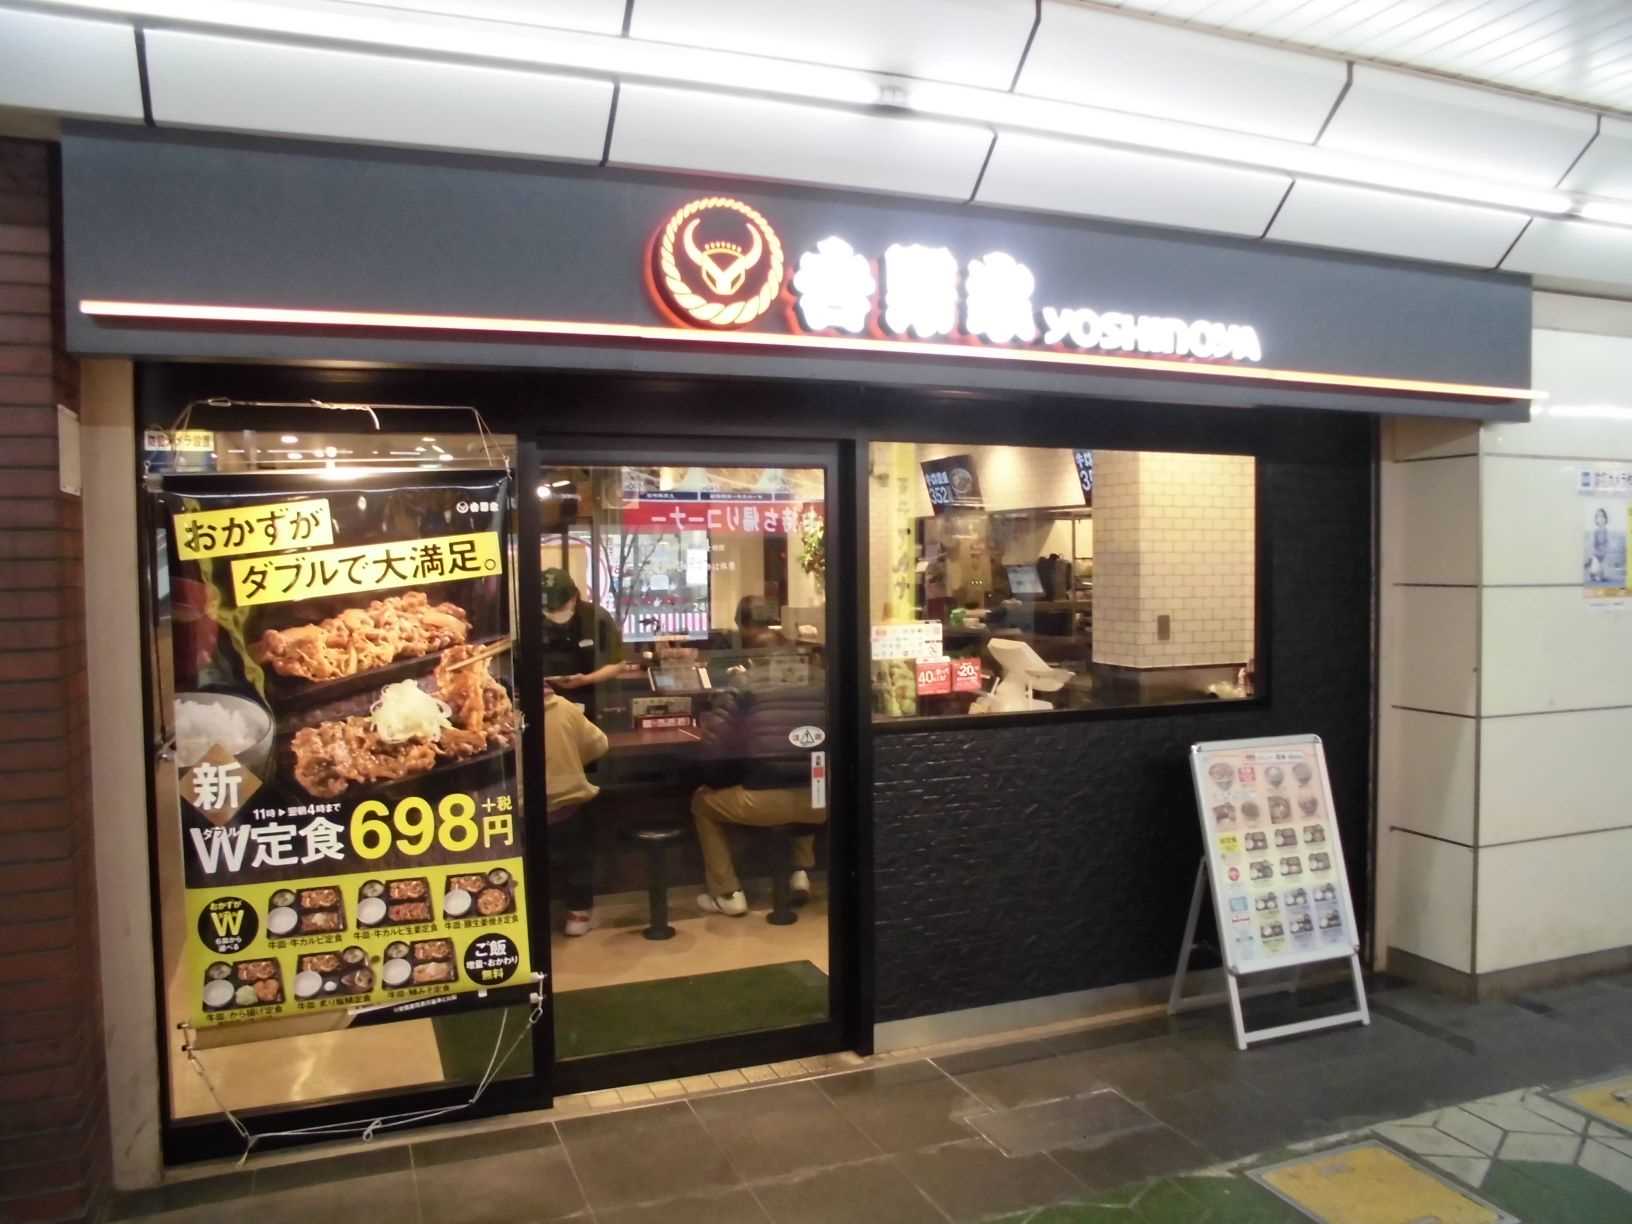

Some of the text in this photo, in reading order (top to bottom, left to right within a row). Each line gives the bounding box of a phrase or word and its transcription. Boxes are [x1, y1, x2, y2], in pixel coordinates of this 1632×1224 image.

[184, 508, 324, 552] おかずが
[242, 540, 497, 598] ダブルで大満足。
[193, 762, 242, 810] 新
[189, 817, 345, 874] W定食
[350, 793, 479, 860] 698
[483, 814, 514, 849] 円
[210, 910, 244, 937] W
[475, 939, 507, 957] ご飯
